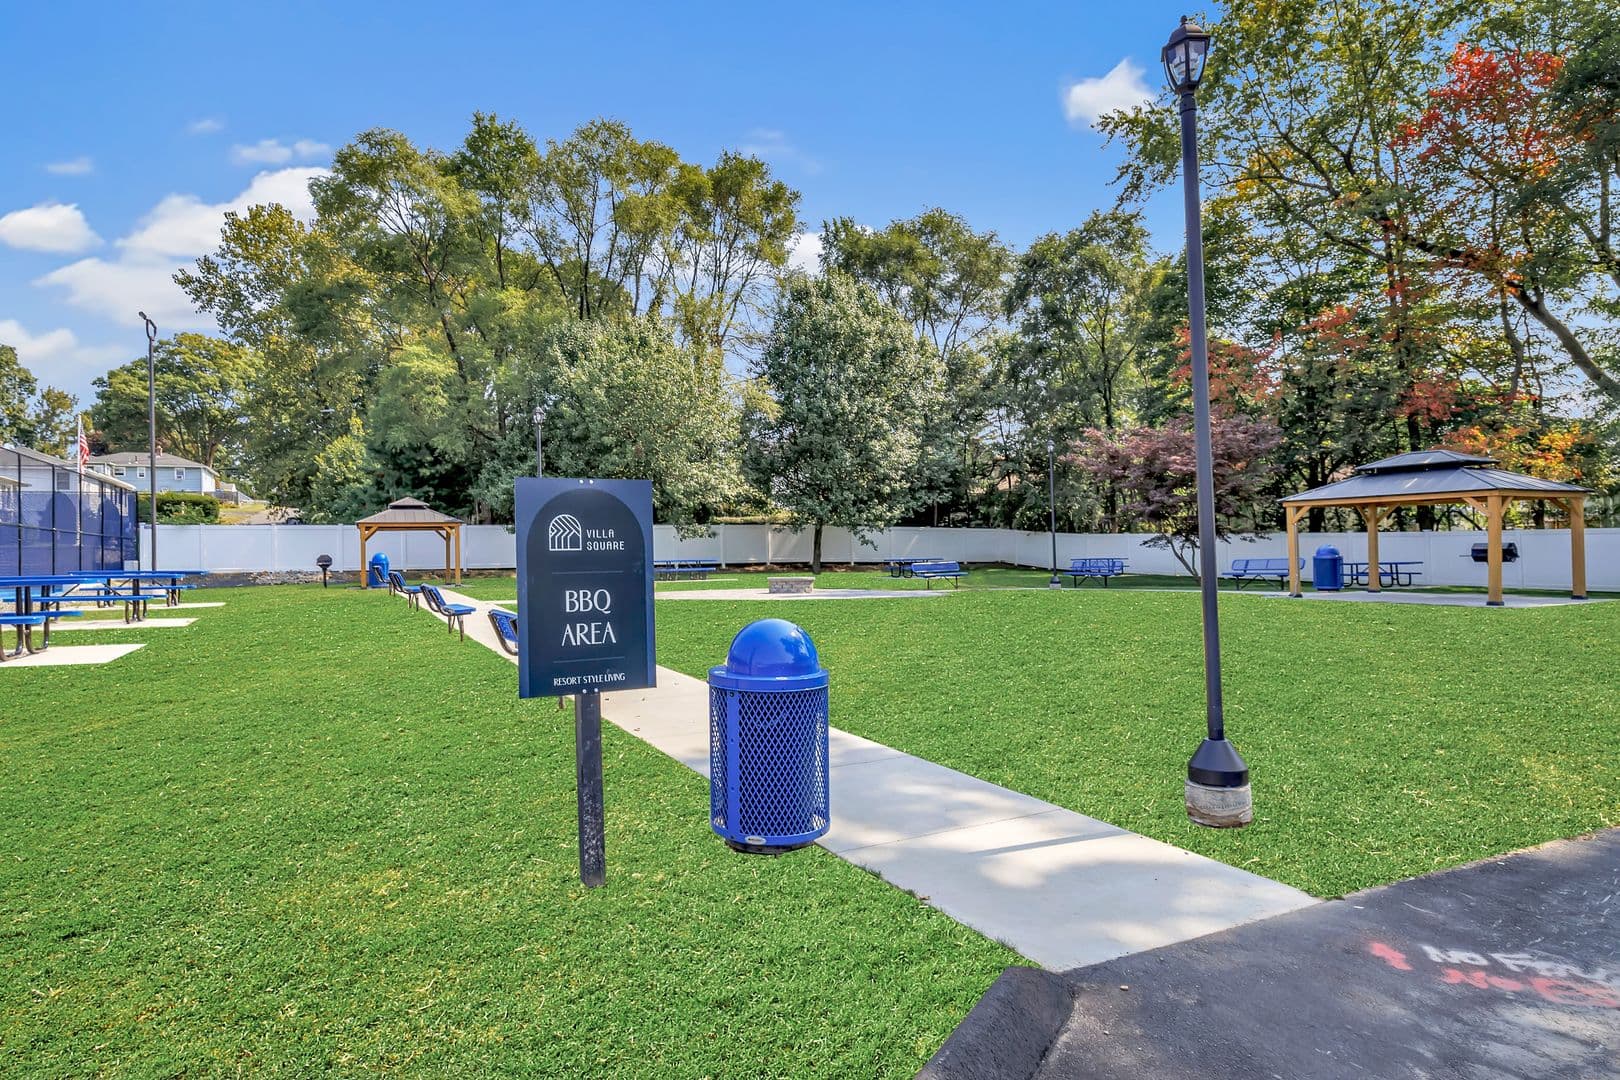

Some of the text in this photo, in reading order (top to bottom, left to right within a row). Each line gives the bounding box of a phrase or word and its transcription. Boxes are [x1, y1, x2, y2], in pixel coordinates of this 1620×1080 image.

[586, 529, 615, 539] VILLA
[586, 540, 625, 551] SQUARE
[565, 589, 612, 615] BBQ
[561, 621, 617, 647] AREA
[553, 672, 626, 687] RESORT STYLE LIVING
